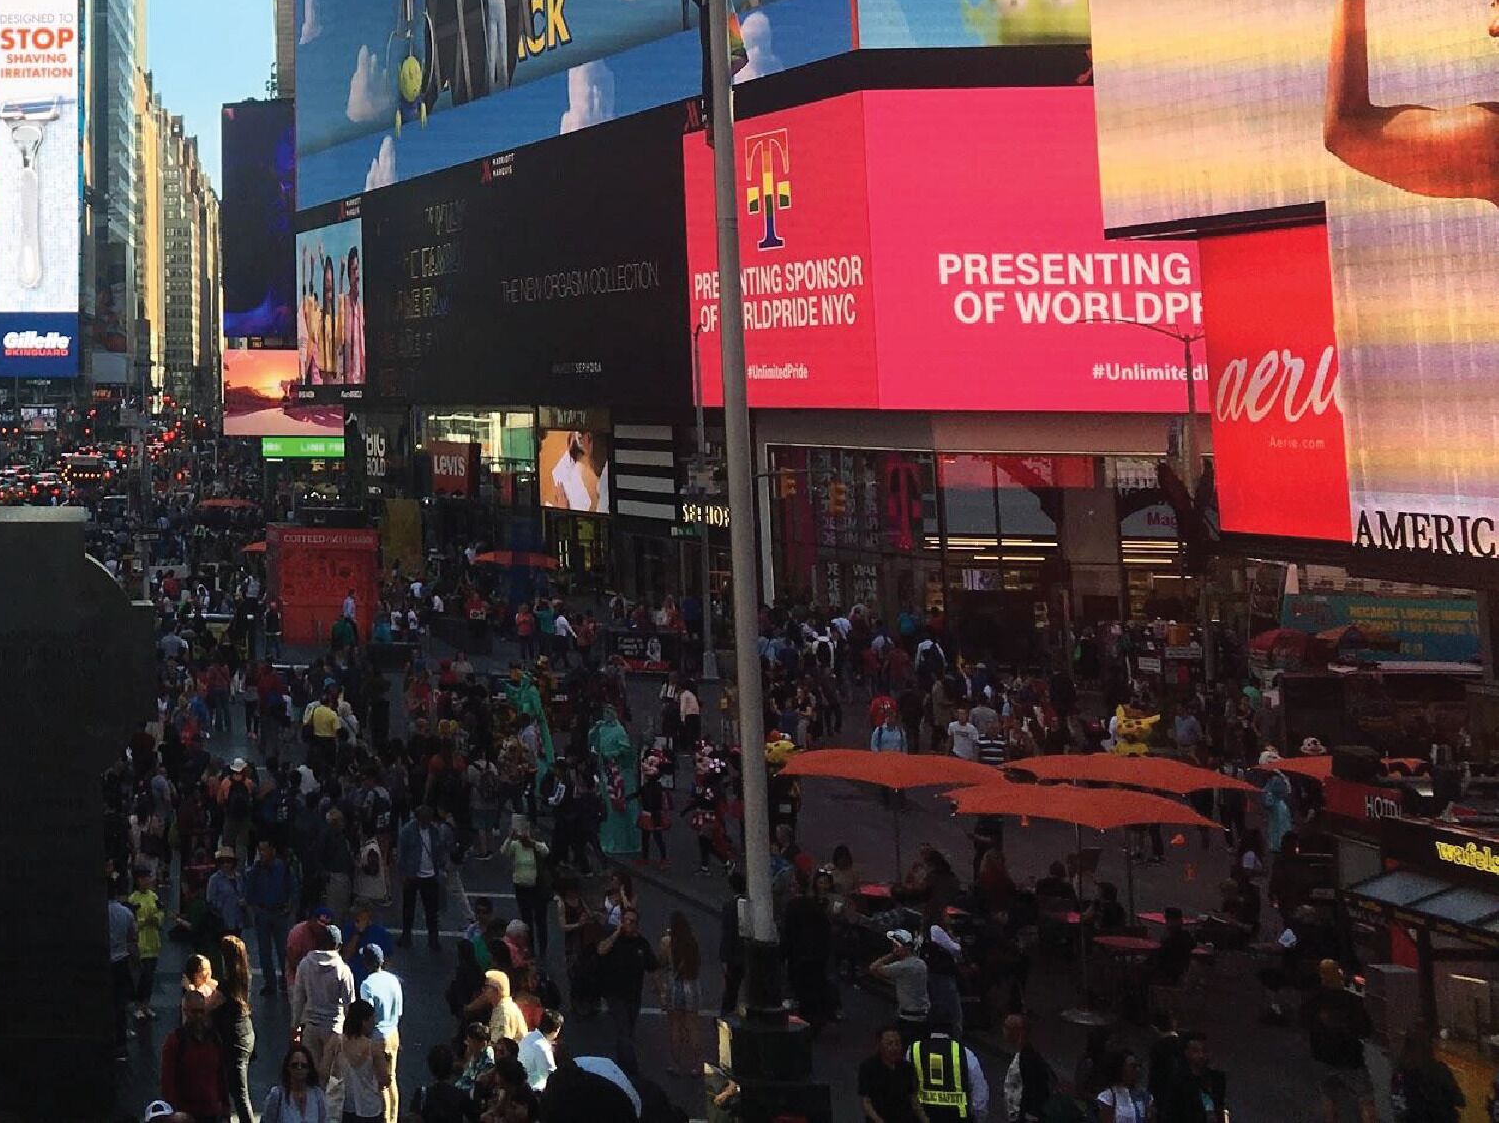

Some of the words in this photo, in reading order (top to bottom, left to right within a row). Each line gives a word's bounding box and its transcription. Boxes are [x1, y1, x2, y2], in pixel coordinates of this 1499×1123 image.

[0, 14, 55, 24] DESIGNED
[59, 13, 74, 24] TO
[0, 28, 75, 50] STOP
[6, 54, 67, 63] SHAVING
[1, 68, 73, 79] IRRITATION
[694, 263, 783, 301] PRENTING
[785, 255, 864, 292] SPONSOR
[938, 252, 1192, 285] PRESENTING
[701, 305, 719, 333] OF
[743, 296, 819, 331] RLDPRIDE
[822, 294, 856, 325] NYC
[954, 291, 1006, 324] OF
[3, 330, 72, 349] Gillette
[4, 348, 69, 357] SKINGUARD
[746, 362, 809, 380] #UnlimitedPride
[1092, 363, 1208, 381] #Unlimited
[366, 428, 386, 458] BIG
[1269, 436, 1326, 450] Aerie.com
[365, 457, 387, 476] BOLD
[1353, 509, 1499, 558] AMERIC
